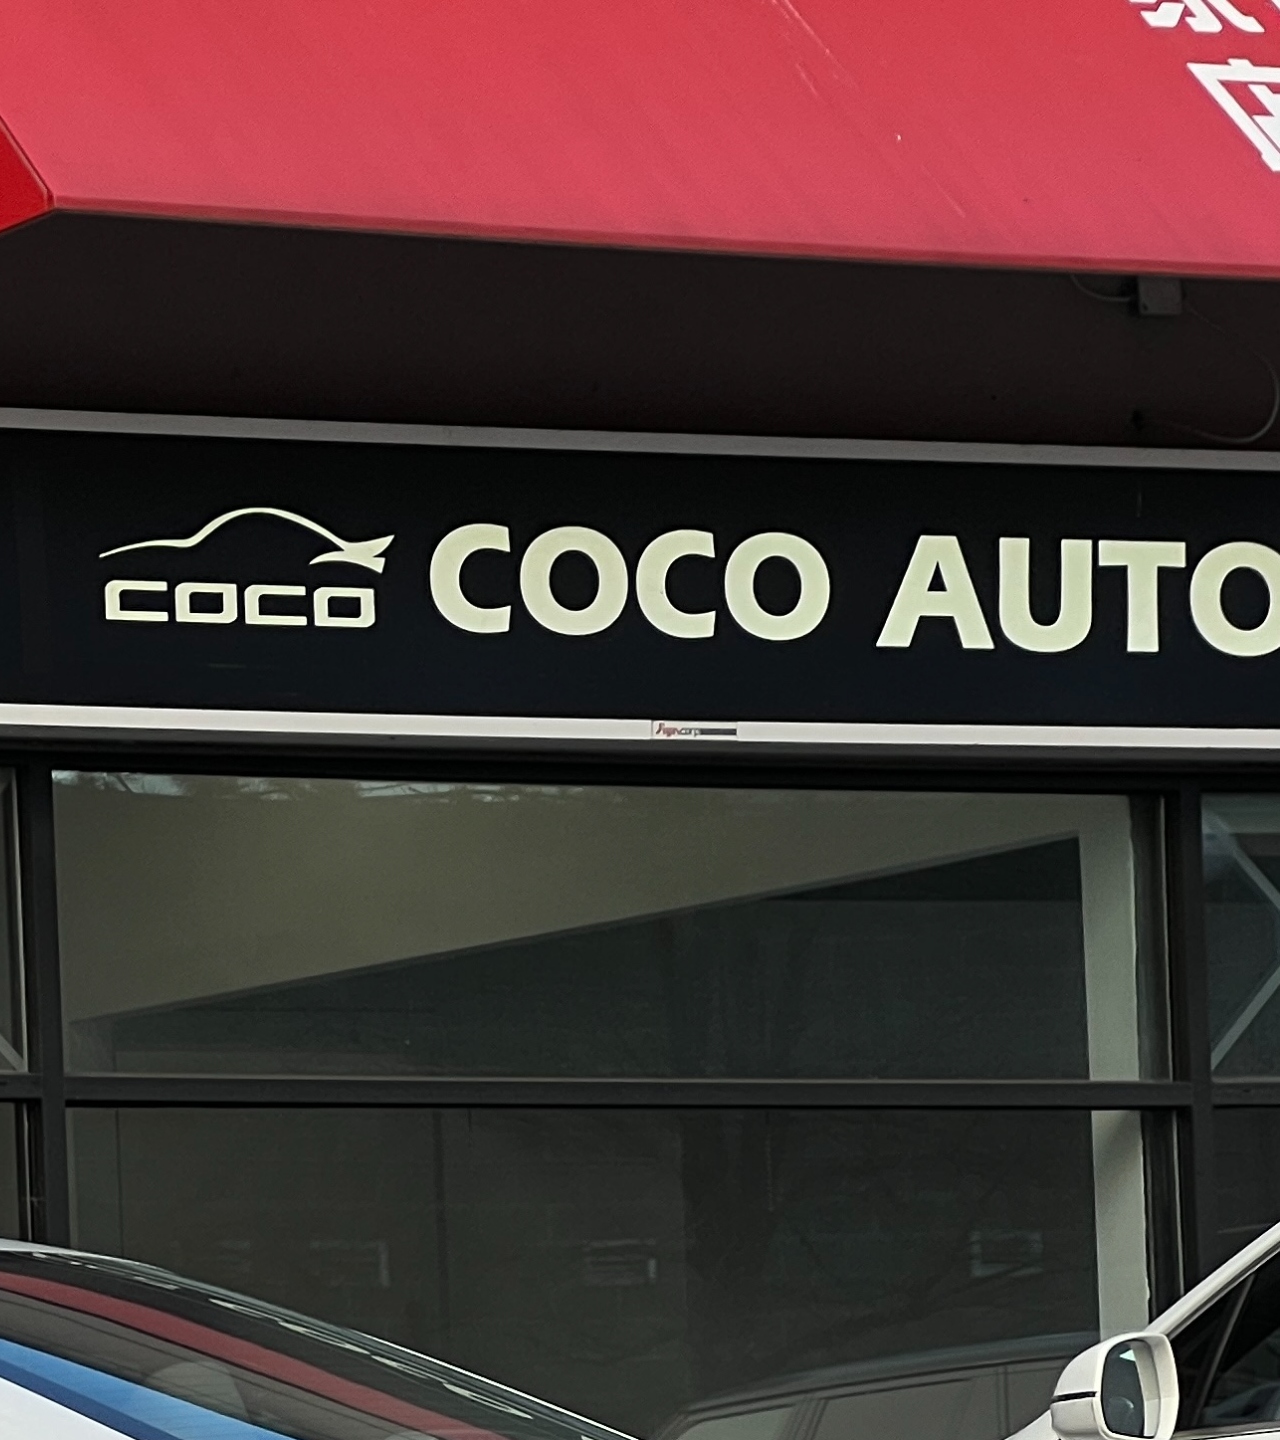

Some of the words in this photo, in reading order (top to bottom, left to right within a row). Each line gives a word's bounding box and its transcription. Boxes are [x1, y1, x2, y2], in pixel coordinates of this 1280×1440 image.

[104, 579, 376, 628] COCO
[428, 522, 831, 642] COCO
[874, 533, 1280, 657] AUTO
